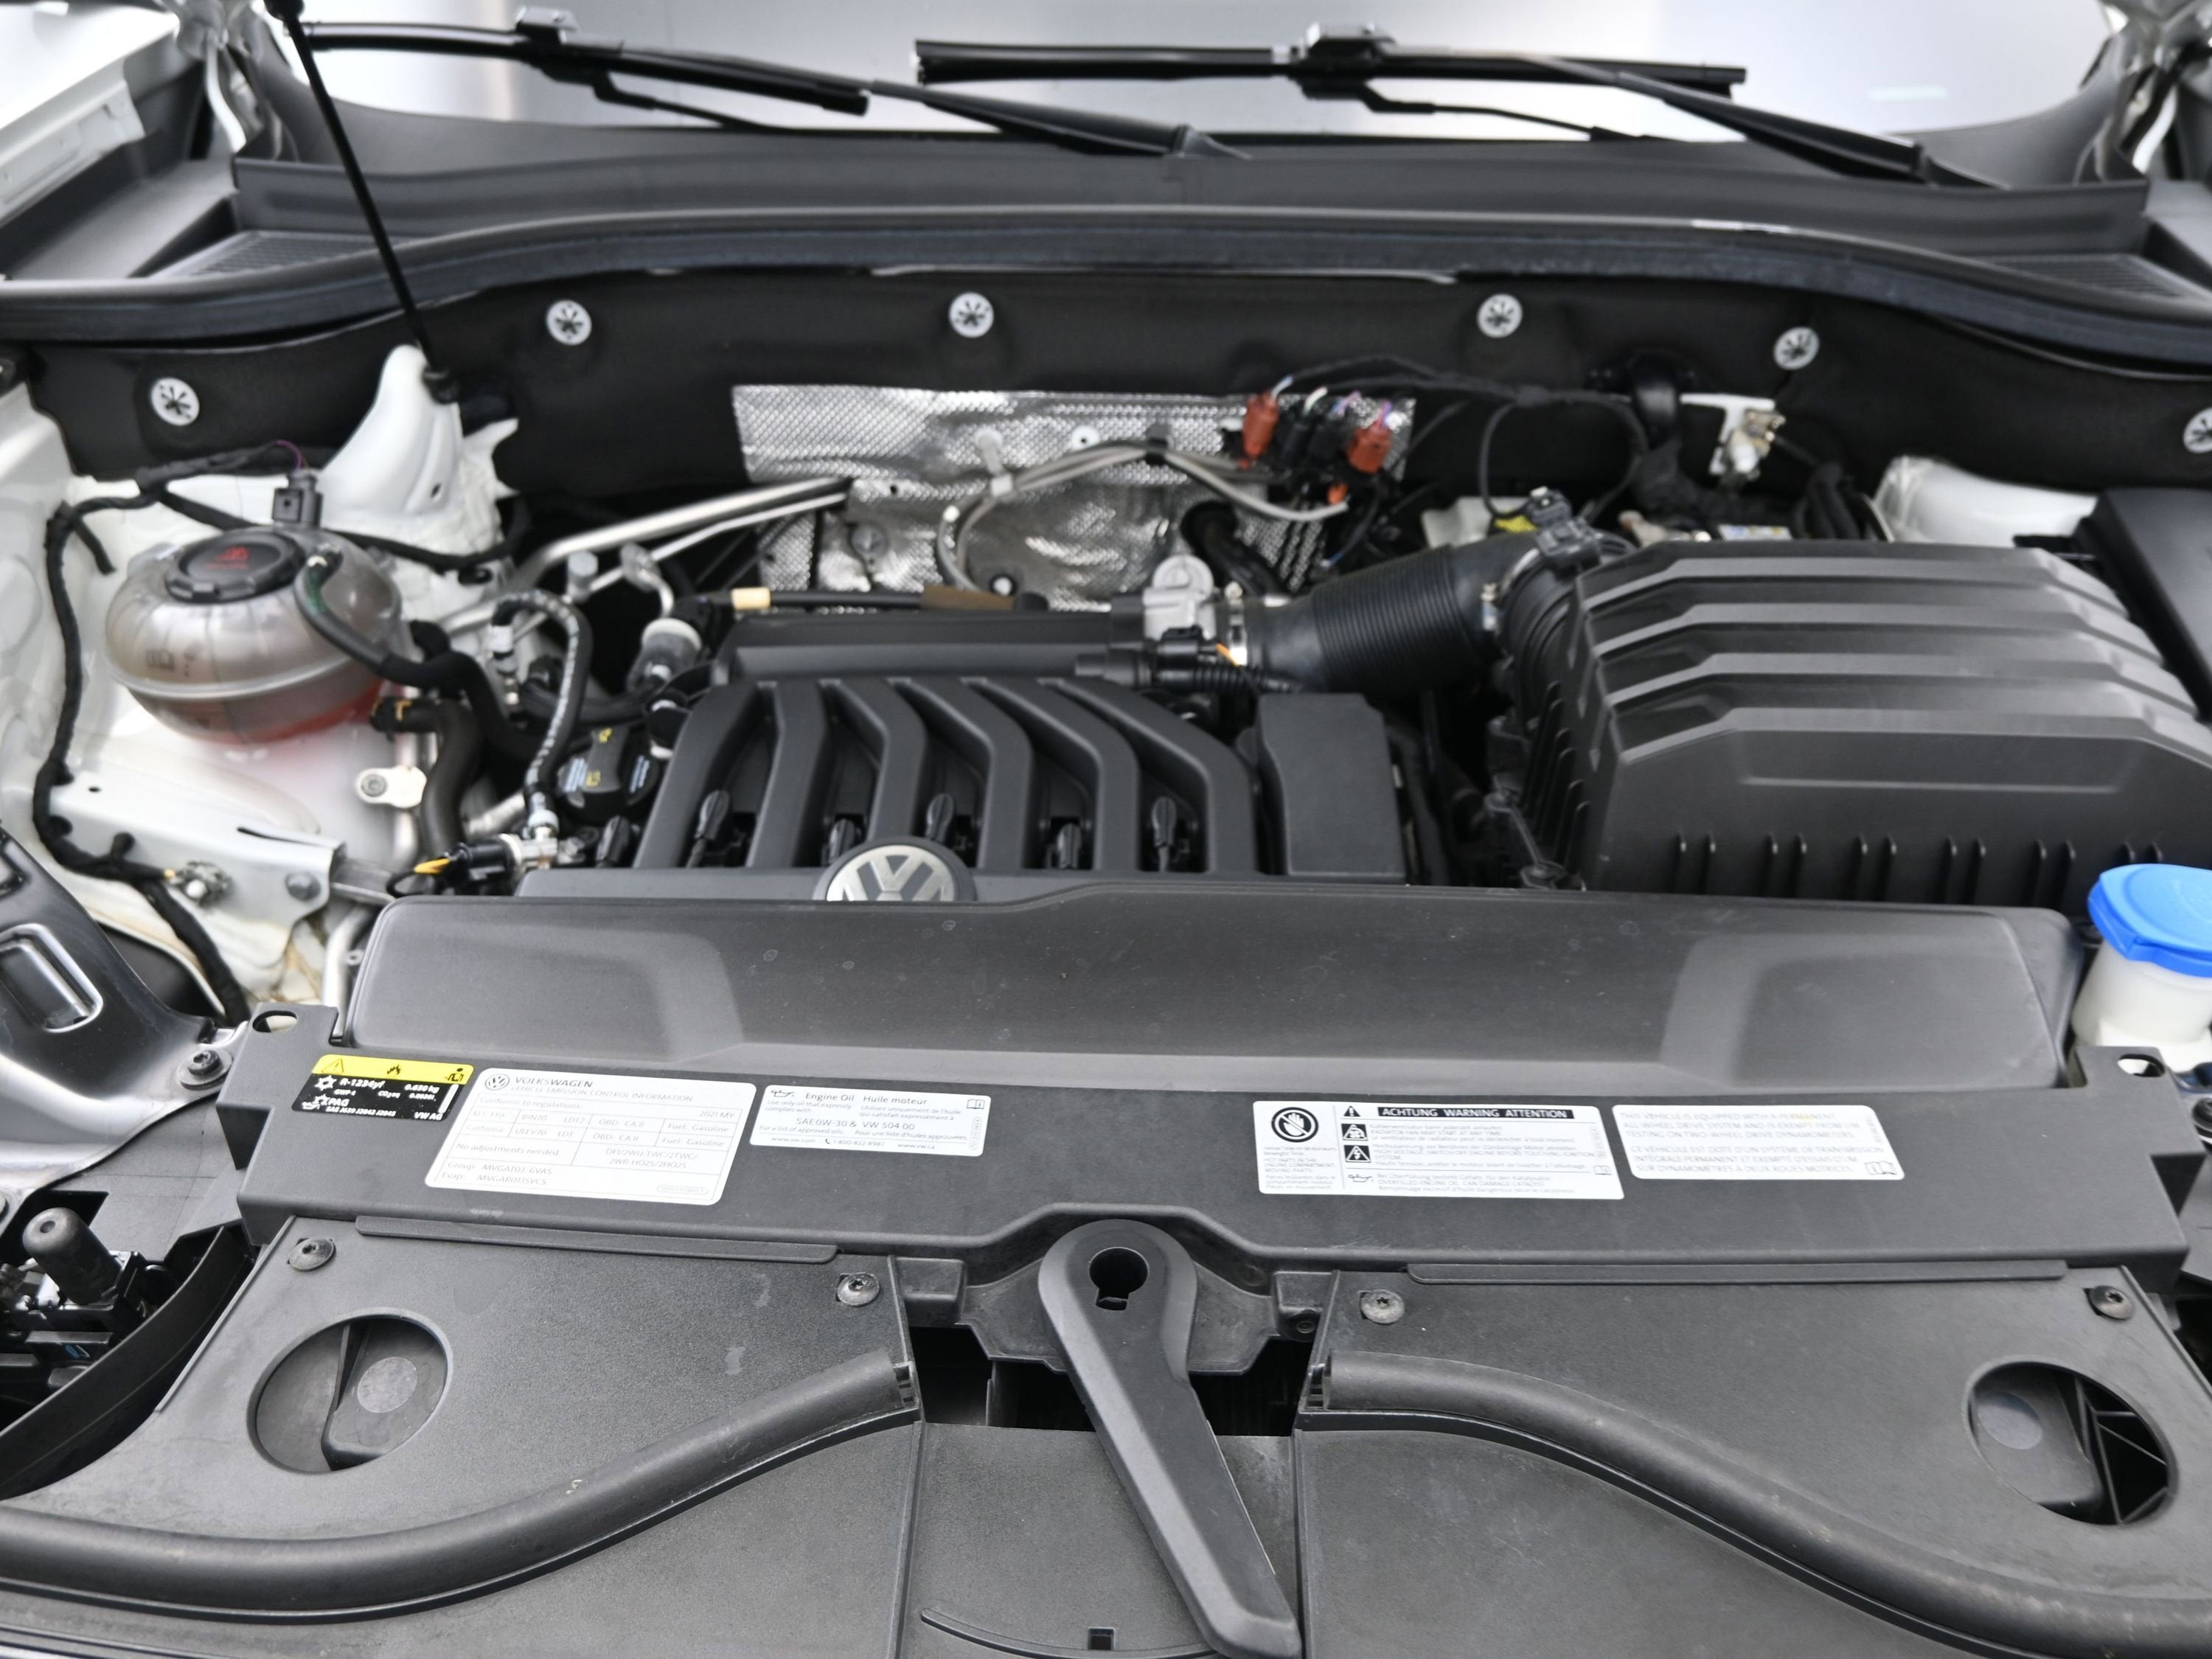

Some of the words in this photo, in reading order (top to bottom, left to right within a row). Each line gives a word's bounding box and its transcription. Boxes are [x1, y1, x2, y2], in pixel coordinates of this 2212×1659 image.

[339, 1077, 386, 1090] R-1234yf
[515, 1077, 593, 1088] VOLKSWAGEN
[428, 1085, 439, 1094] kg
[589, 1090, 629, 1098] CONTROL
[632, 1093, 693, 1102] INFORMATION
[805, 1093, 838, 1102] Engine
[327, 1098, 349, 1107] PAG
[1382, 1108, 1438, 1117] ACHTUNG
[1444, 1109, 1500, 1117] WARNING
[1506, 1109, 1568, 1118] ATTENTION
[815, 1119, 848, 1127] 0W-30
[692, 1124, 729, 1133] Gasoline
[686, 1138, 724, 1147] Gasoline
[470, 1144, 524, 1153] adjustments
